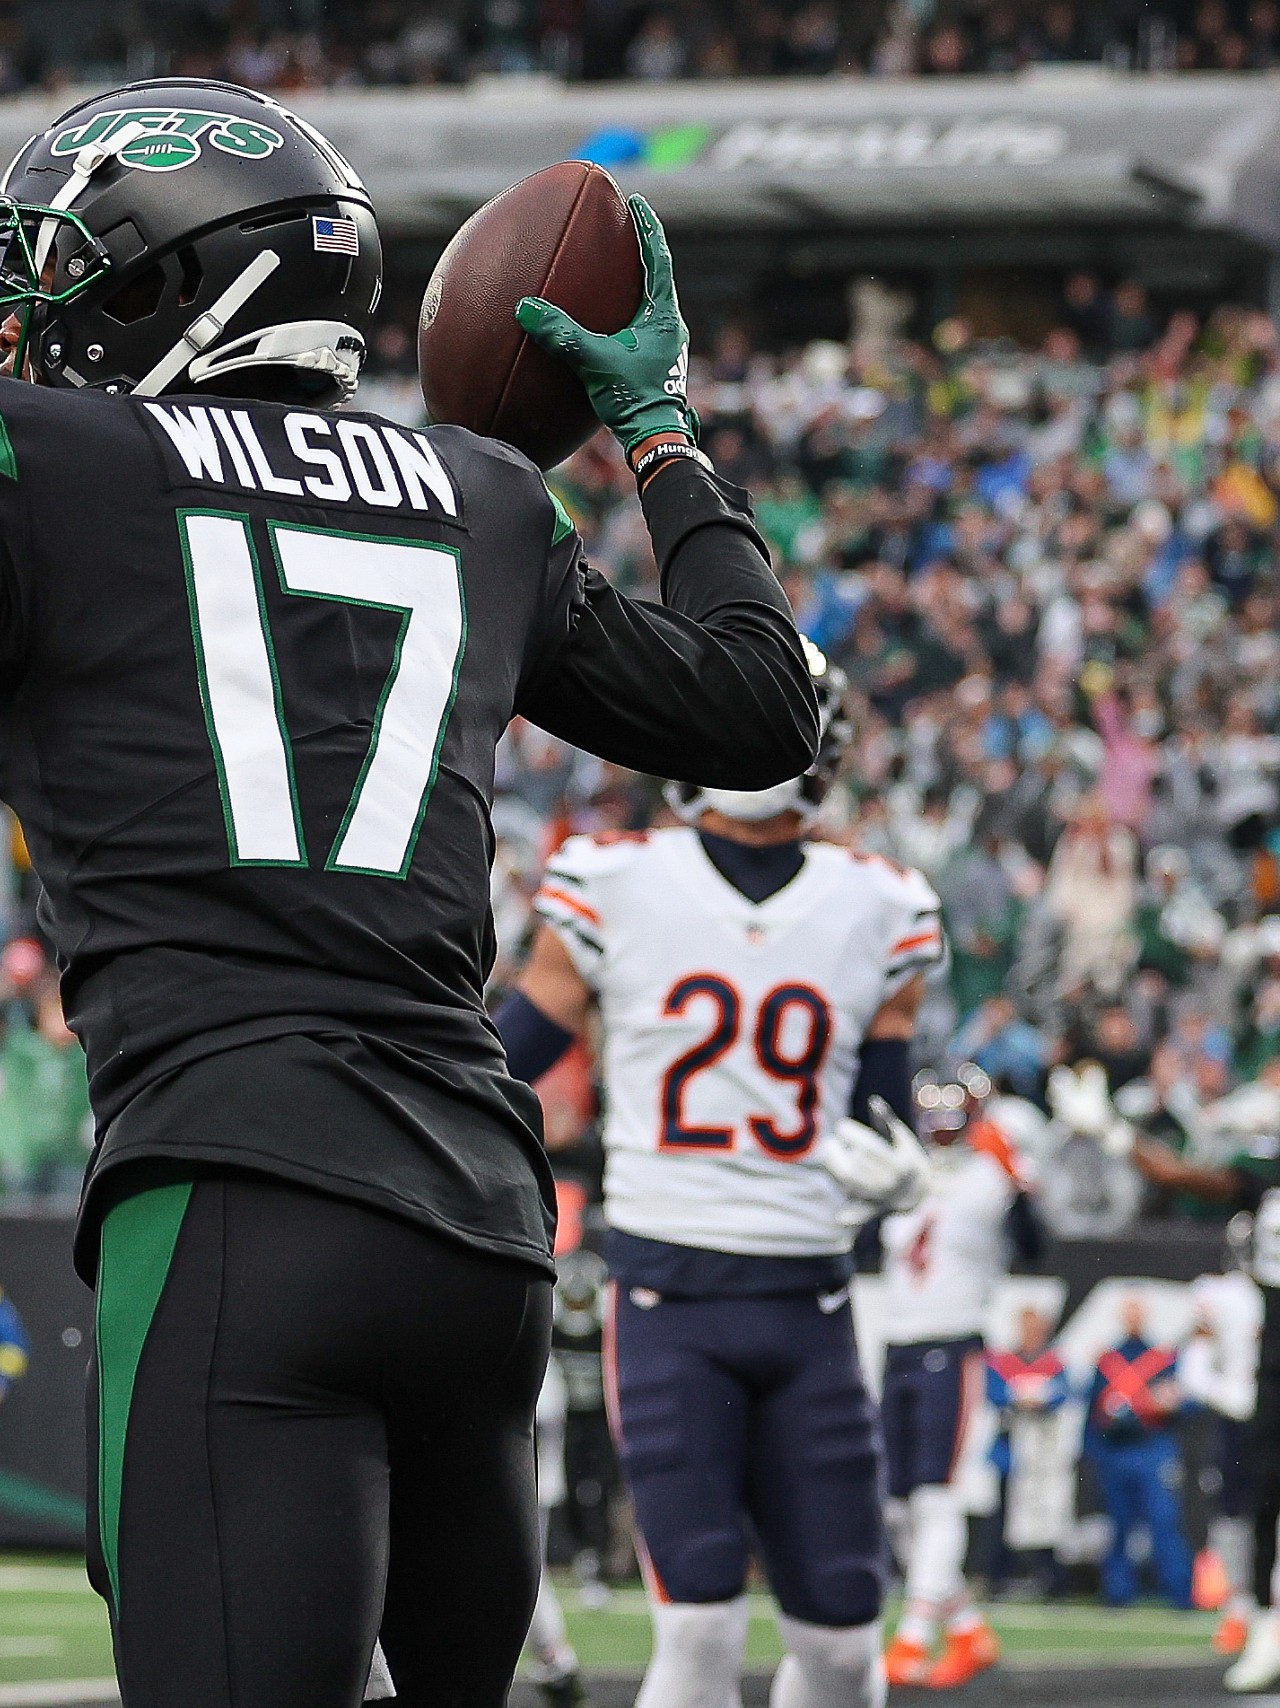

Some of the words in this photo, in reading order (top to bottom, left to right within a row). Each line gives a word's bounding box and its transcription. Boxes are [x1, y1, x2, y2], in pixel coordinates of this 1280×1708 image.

[144, 402, 458, 517] WILSON
[175, 508, 469, 881] 17
[658, 970, 833, 1163] 29
